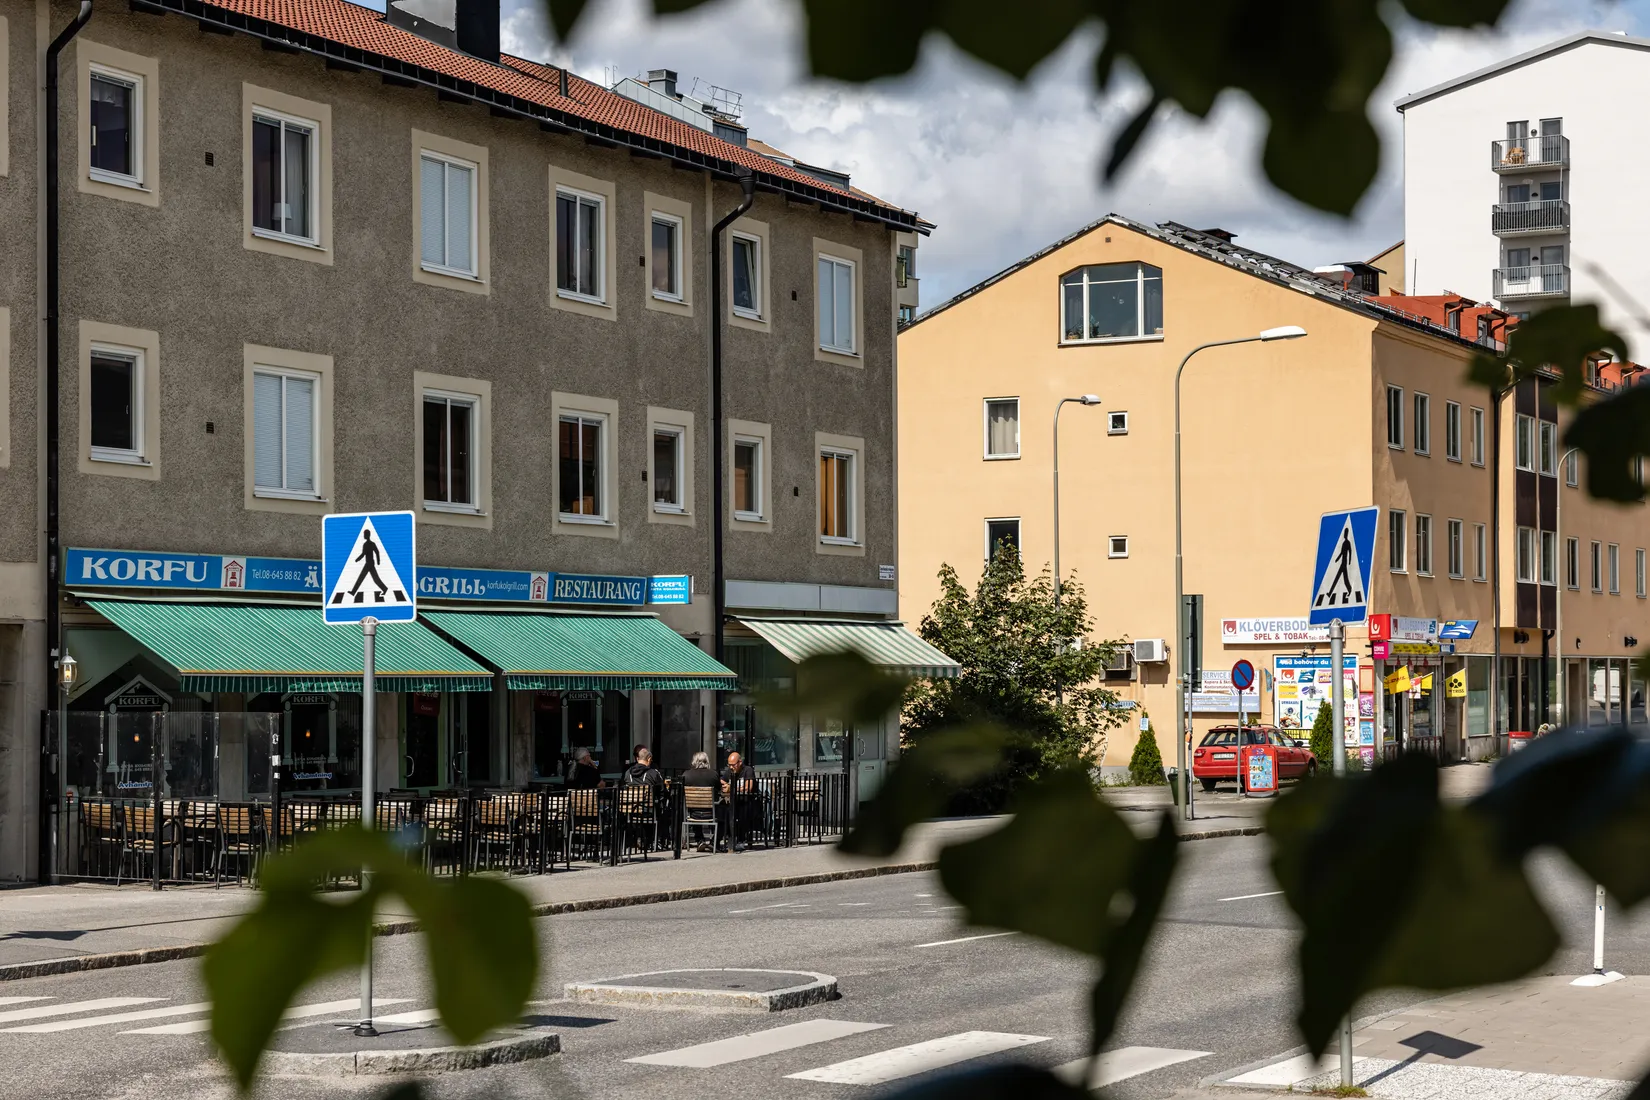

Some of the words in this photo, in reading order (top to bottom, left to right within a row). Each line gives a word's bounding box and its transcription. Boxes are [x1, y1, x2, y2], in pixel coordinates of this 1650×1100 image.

[82, 557, 208, 582] KORFU
[252, 569, 284, 580] Tel.08-645
[284, 570, 293, 580] 88
[293, 571, 301, 580] 82
[304, 565, 322, 588] Ä
[487, 580, 528, 592] korfukolgrill.com
[554, 579, 640, 600] RESTAURANG
[1239, 619, 1322, 632] KLÖVERBOD
[1253, 633, 1271, 641] SPEL
[1284, 632, 1308, 640] TOBAK
[119, 697, 160, 705] KORFU
[293, 695, 328, 703] KORFU
